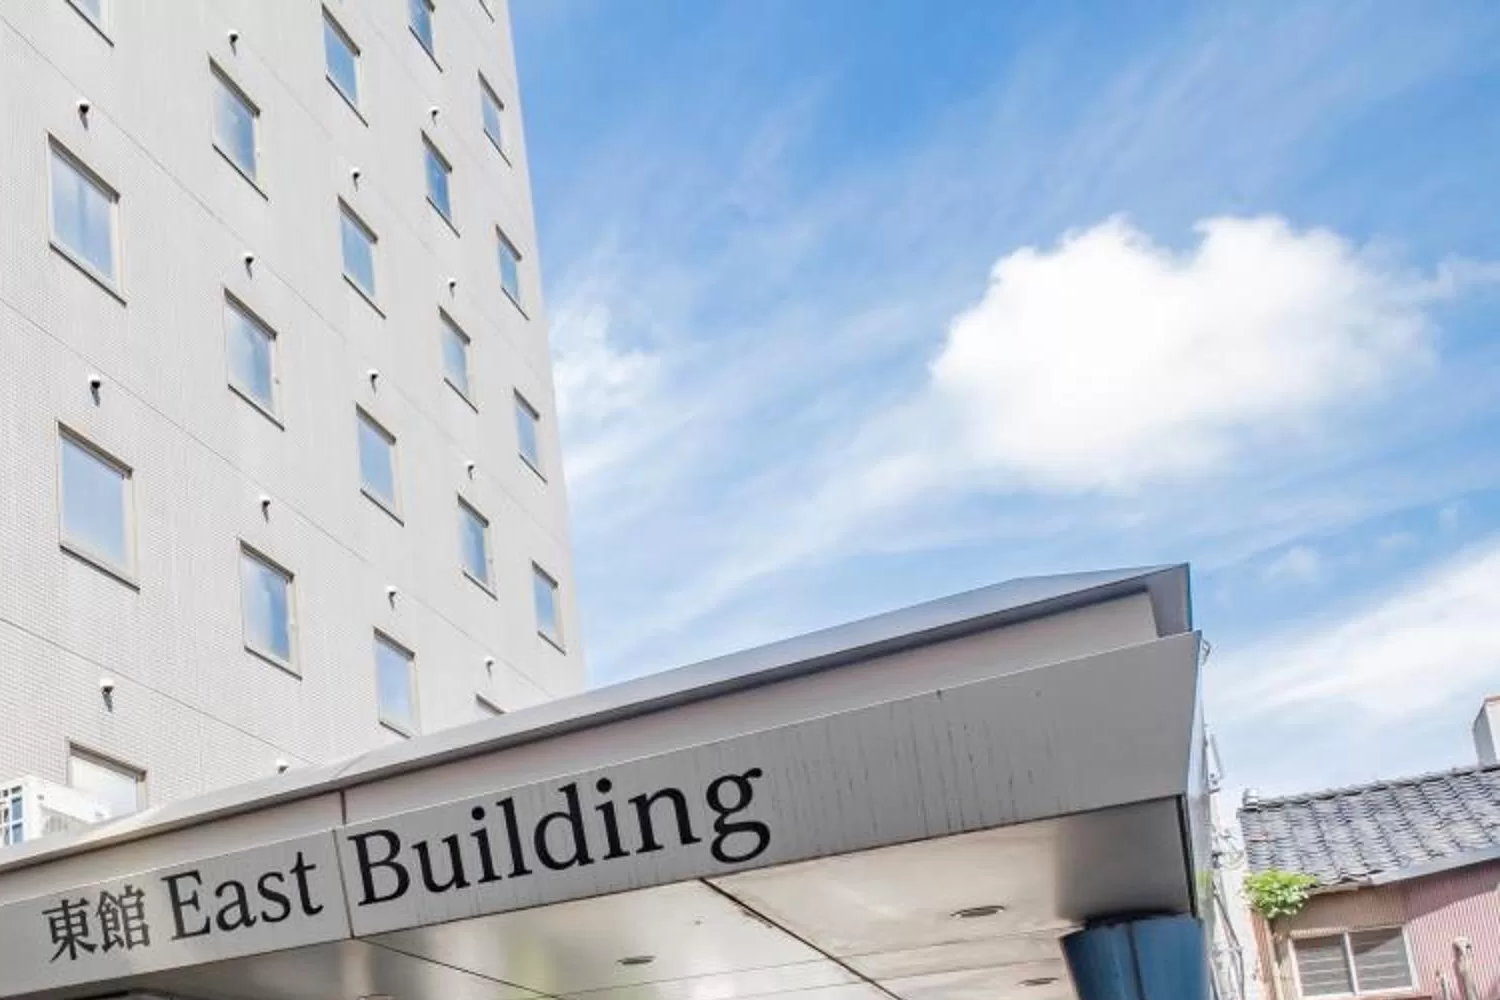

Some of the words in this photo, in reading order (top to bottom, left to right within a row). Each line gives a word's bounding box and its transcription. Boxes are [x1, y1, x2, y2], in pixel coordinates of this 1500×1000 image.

[42, 884, 150, 963] 東館
[161, 850, 324, 941] East
[347, 766, 772, 907] Building
